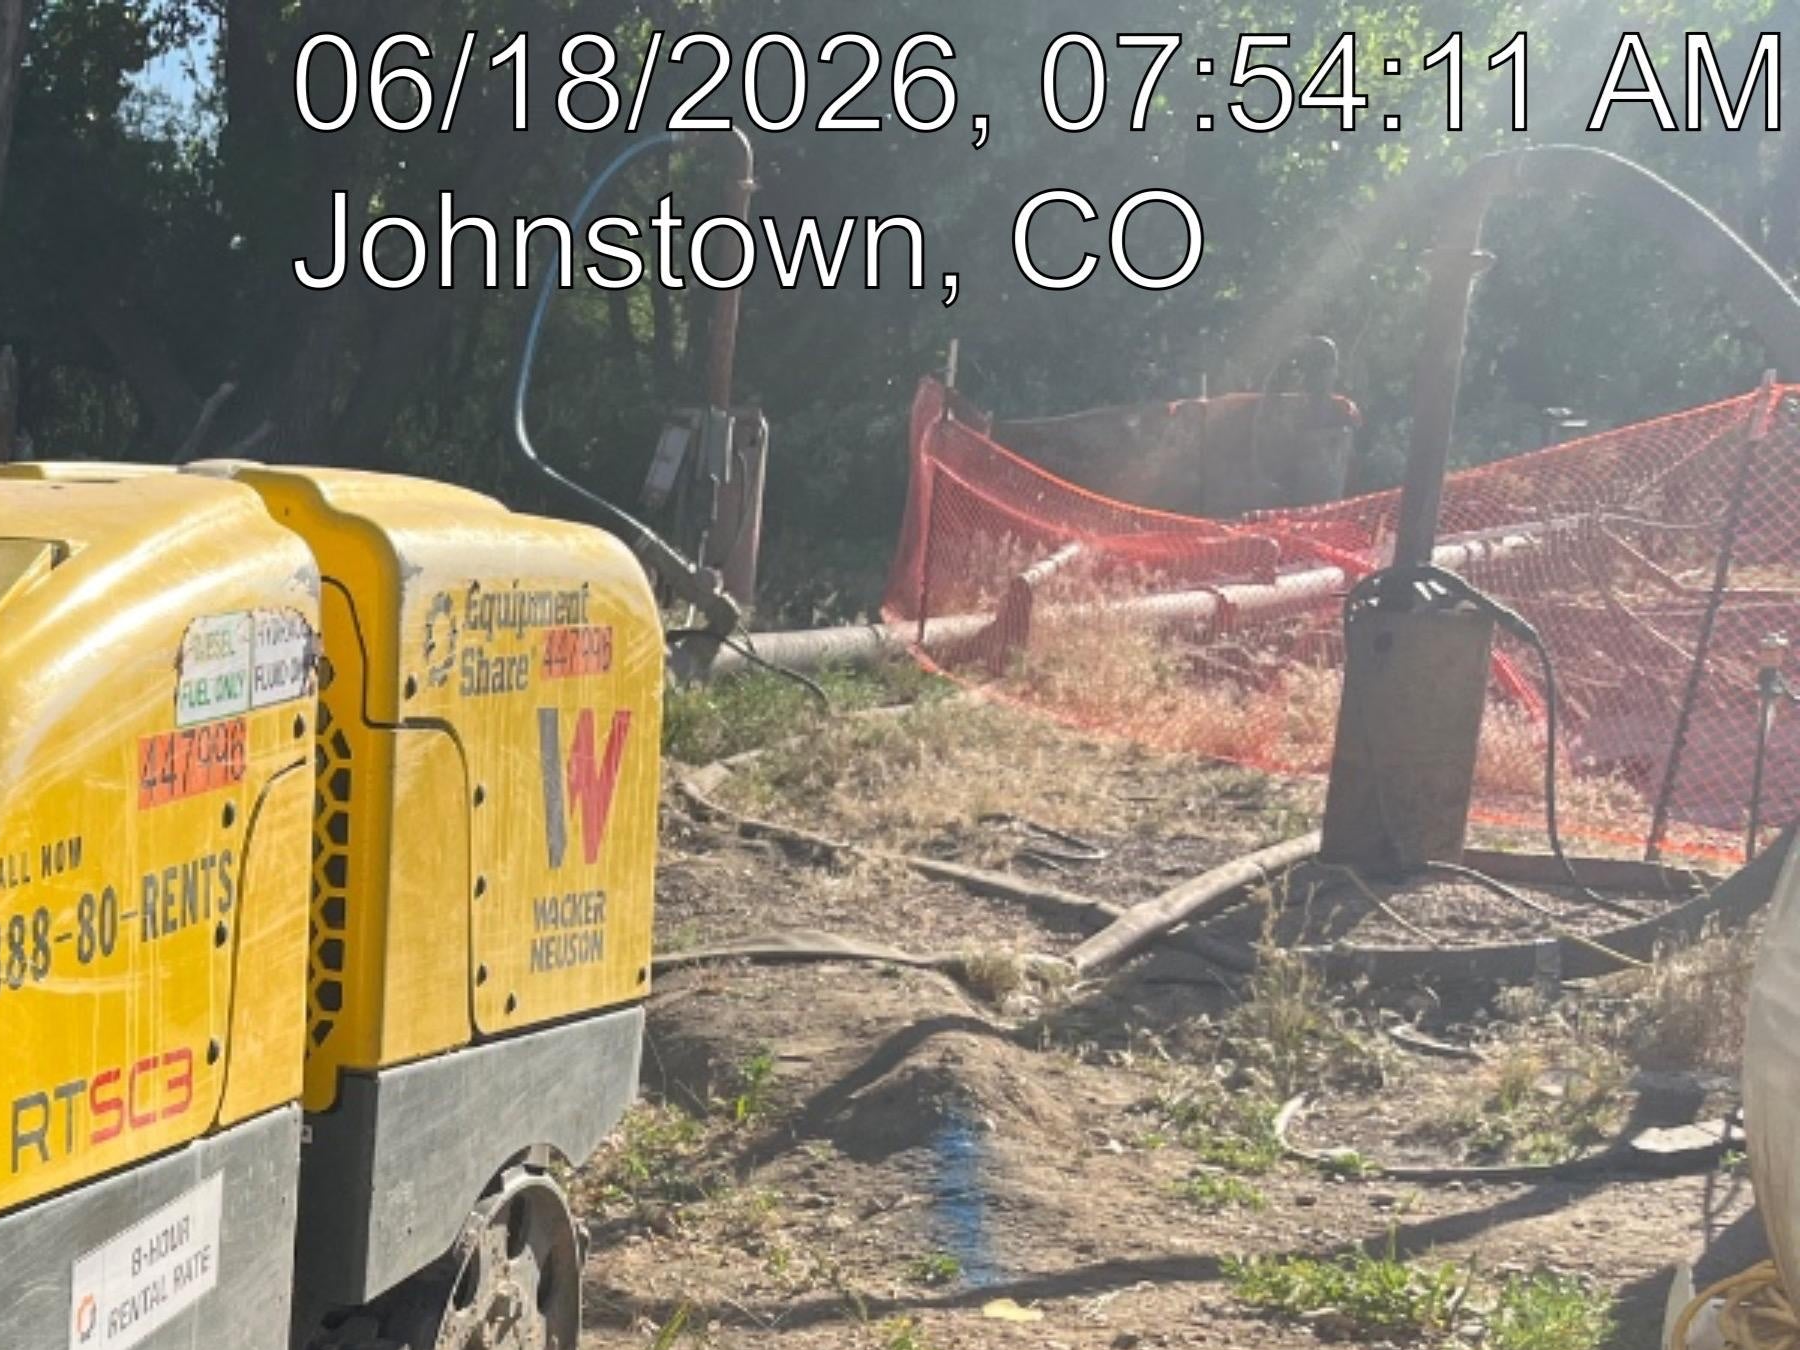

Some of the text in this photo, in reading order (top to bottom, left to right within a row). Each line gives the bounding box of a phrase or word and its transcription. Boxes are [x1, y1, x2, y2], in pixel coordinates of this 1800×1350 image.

[463, 579, 589, 641] Equipment
[460, 646, 529, 697] Share
[141, 717, 246, 802] 447996
[41, 836, 83, 879] NOW
[533, 890, 606, 932] WACKER
[530, 928, 604, 975] NEUSON
[11, 1047, 194, 1174] RTSC3
[132, 1215, 191, 1278] 8-HOUR
[107, 1243, 212, 1340] RENTAL RATE
